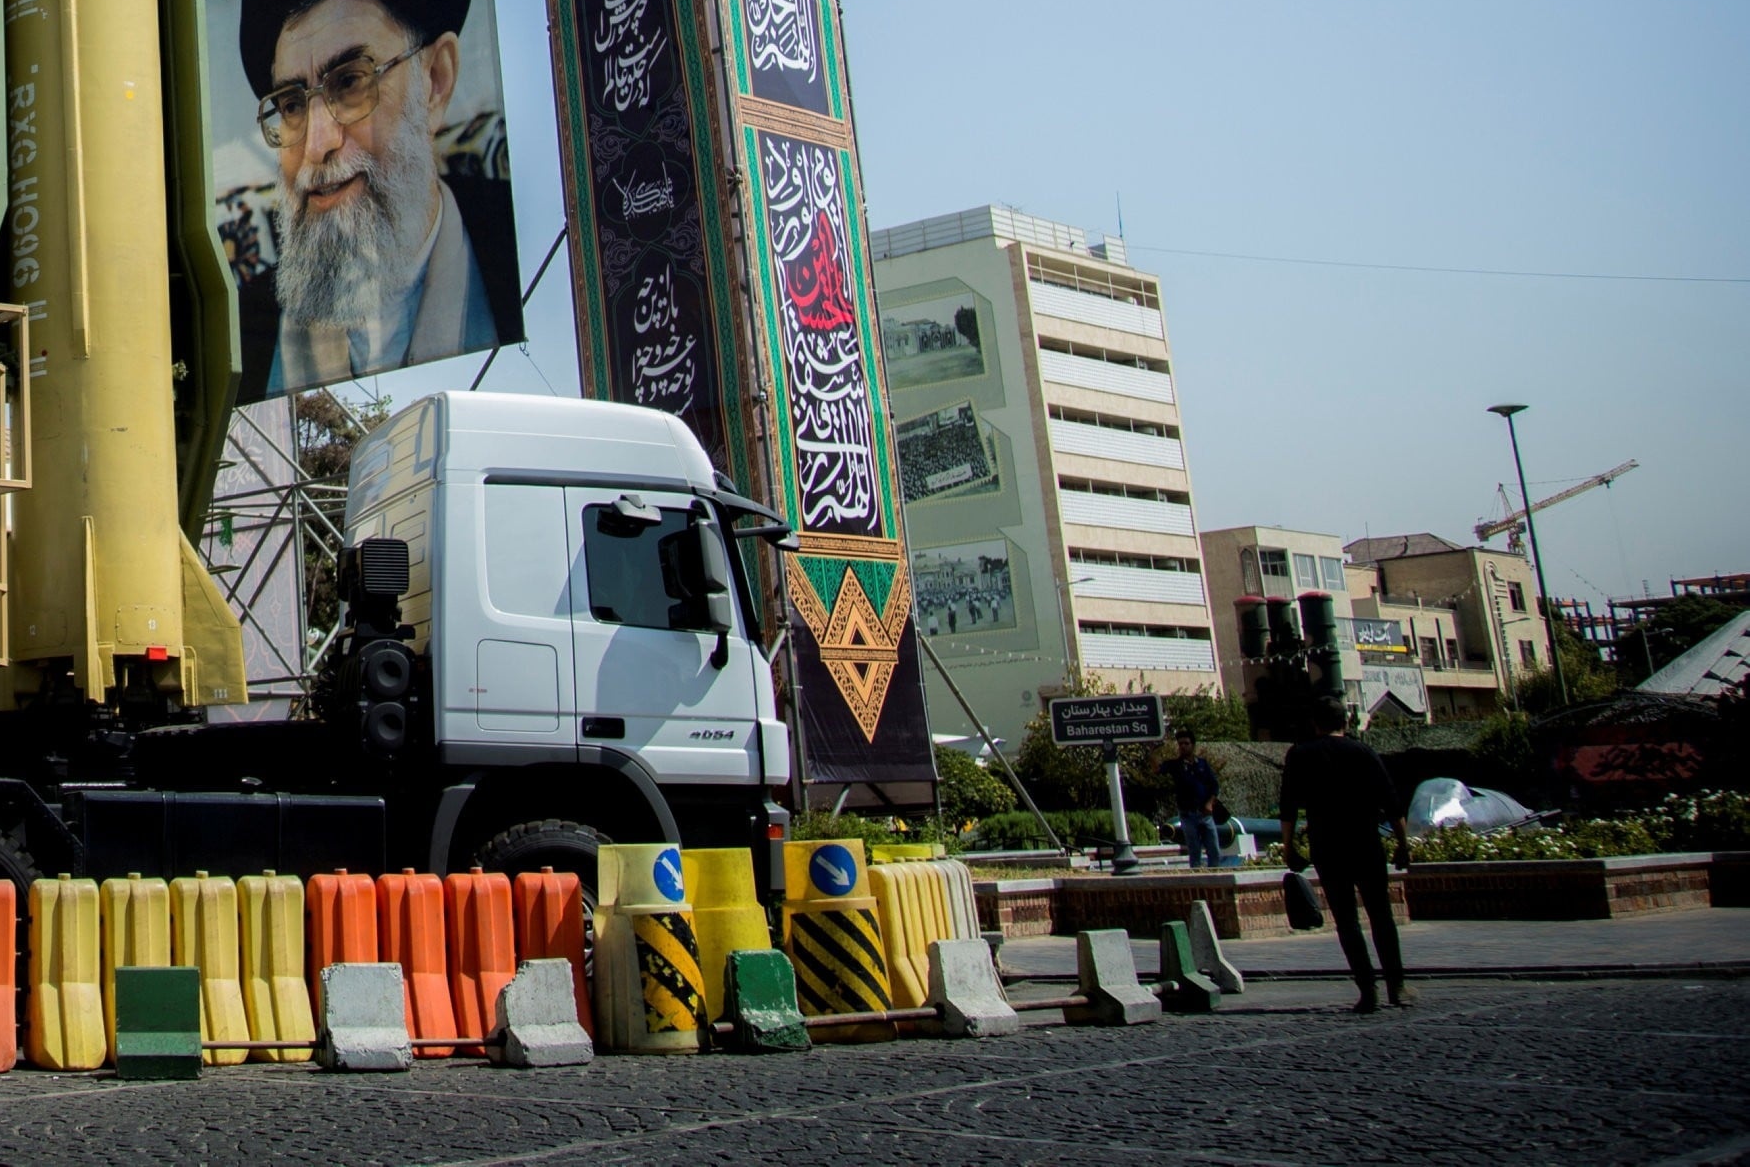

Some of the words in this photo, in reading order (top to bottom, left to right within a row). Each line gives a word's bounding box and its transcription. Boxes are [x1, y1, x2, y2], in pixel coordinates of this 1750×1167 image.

[1061, 703, 1110, 719] بهارستان
[1113, 702, 1149, 716] میدان
[1066, 723, 1129, 737] Baharestan
[1132, 721, 1148, 734] Sq
